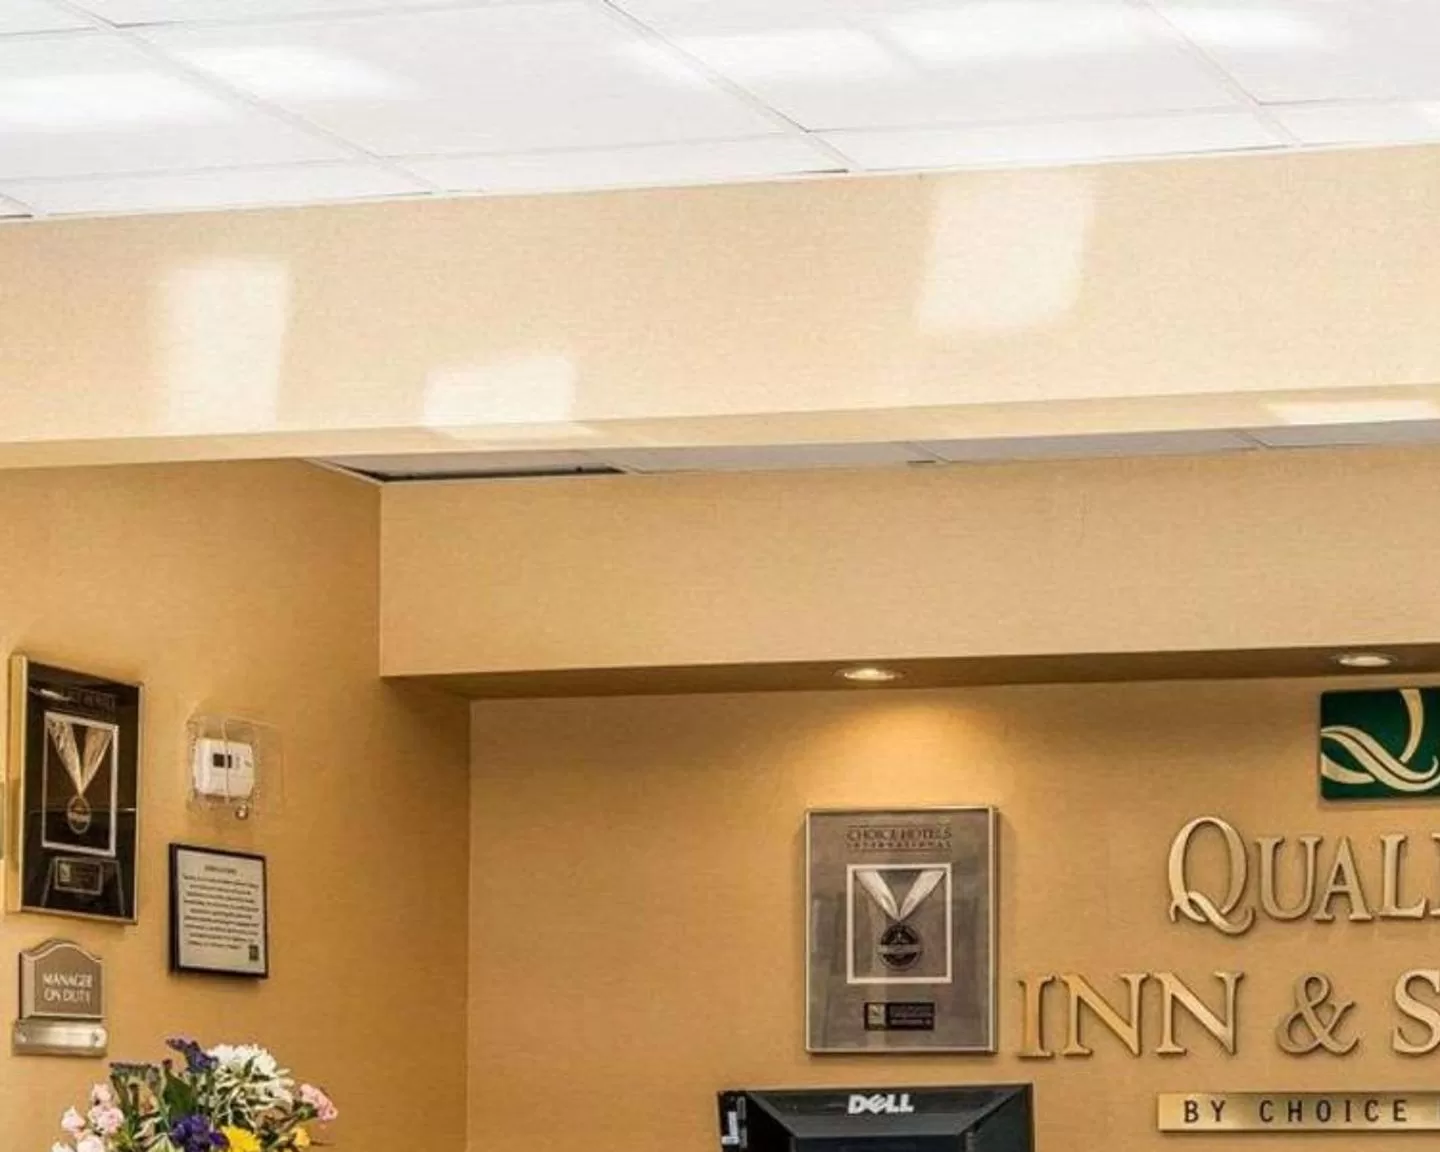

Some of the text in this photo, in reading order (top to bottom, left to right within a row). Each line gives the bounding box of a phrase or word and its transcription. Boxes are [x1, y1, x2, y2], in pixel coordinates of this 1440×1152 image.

[1017, 970, 1245, 1060] INN
[1276, 971, 1361, 1056] &
[847, 1093, 915, 1115] DELL
[1184, 1099, 1226, 1123] BY
[1259, 1098, 1408, 1123] CHOICE
